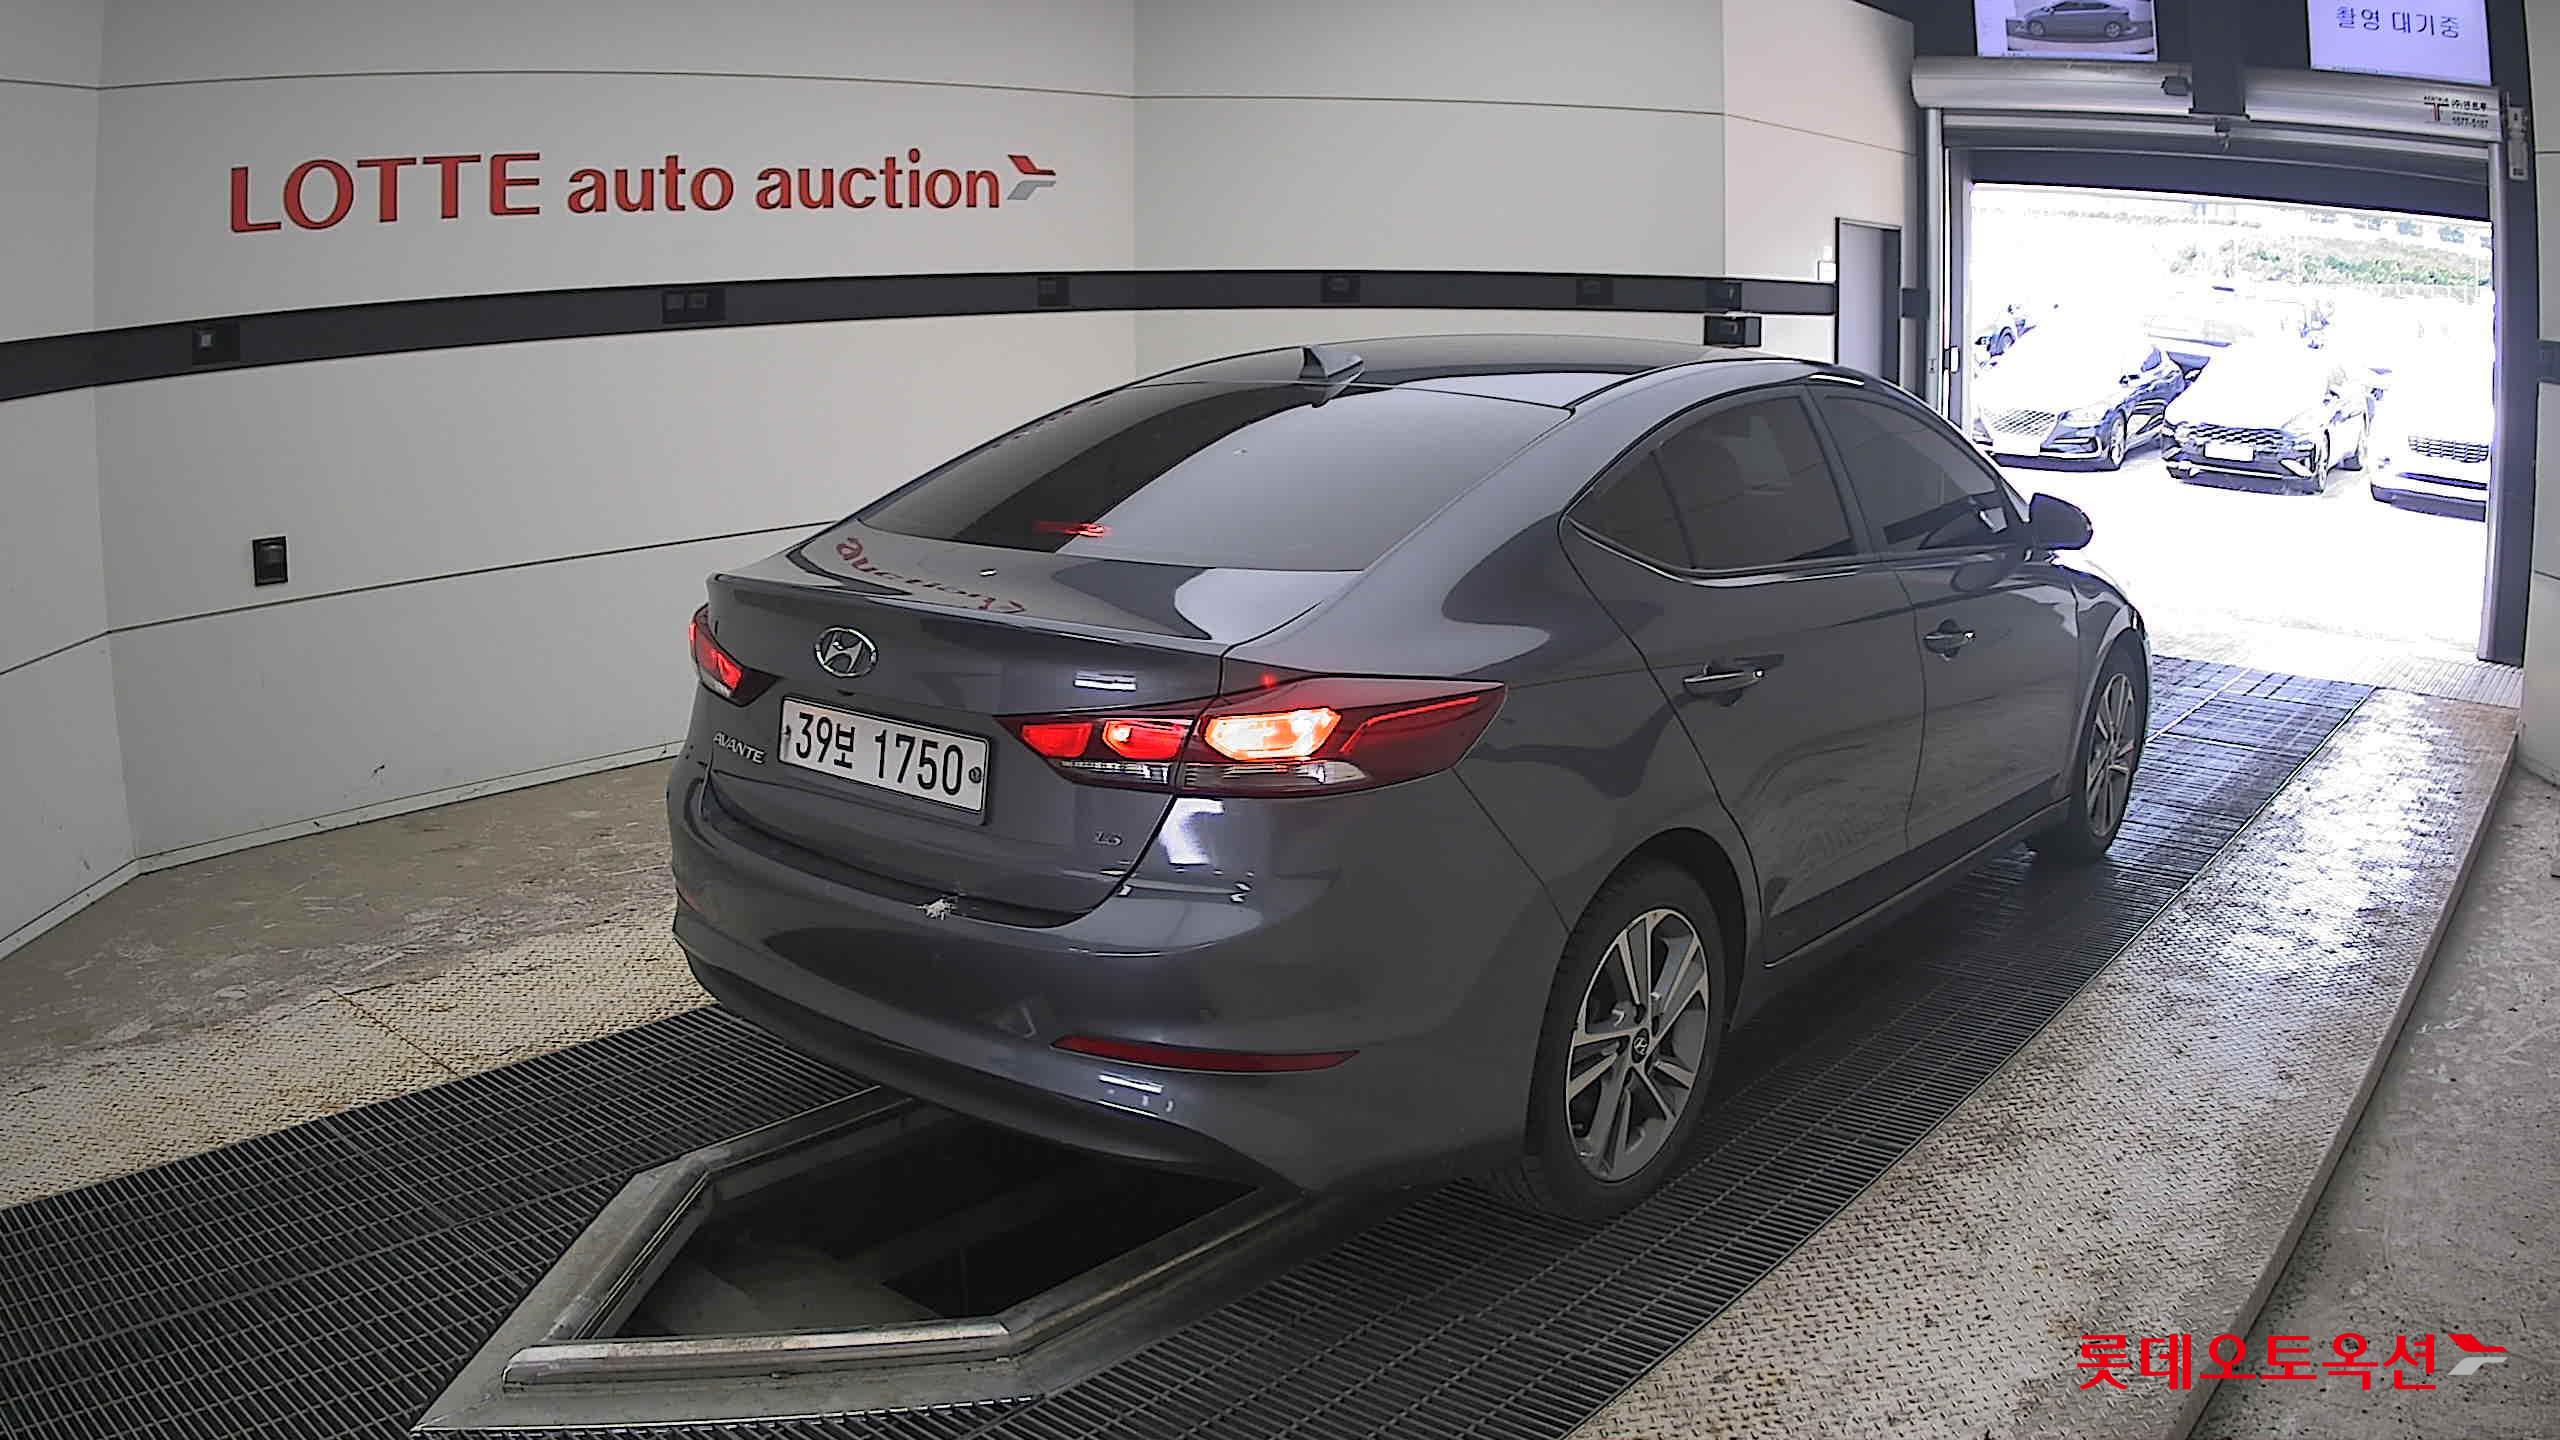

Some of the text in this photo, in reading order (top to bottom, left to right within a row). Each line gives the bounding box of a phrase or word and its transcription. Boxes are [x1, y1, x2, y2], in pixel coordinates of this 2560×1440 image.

[2336, 6, 2460, 39] 촬영 대기중
[230, 148, 1001, 234] LOTTE auto auction
[712, 731, 767, 764] AVANTE
[796, 712, 963, 796] 39보 1750
